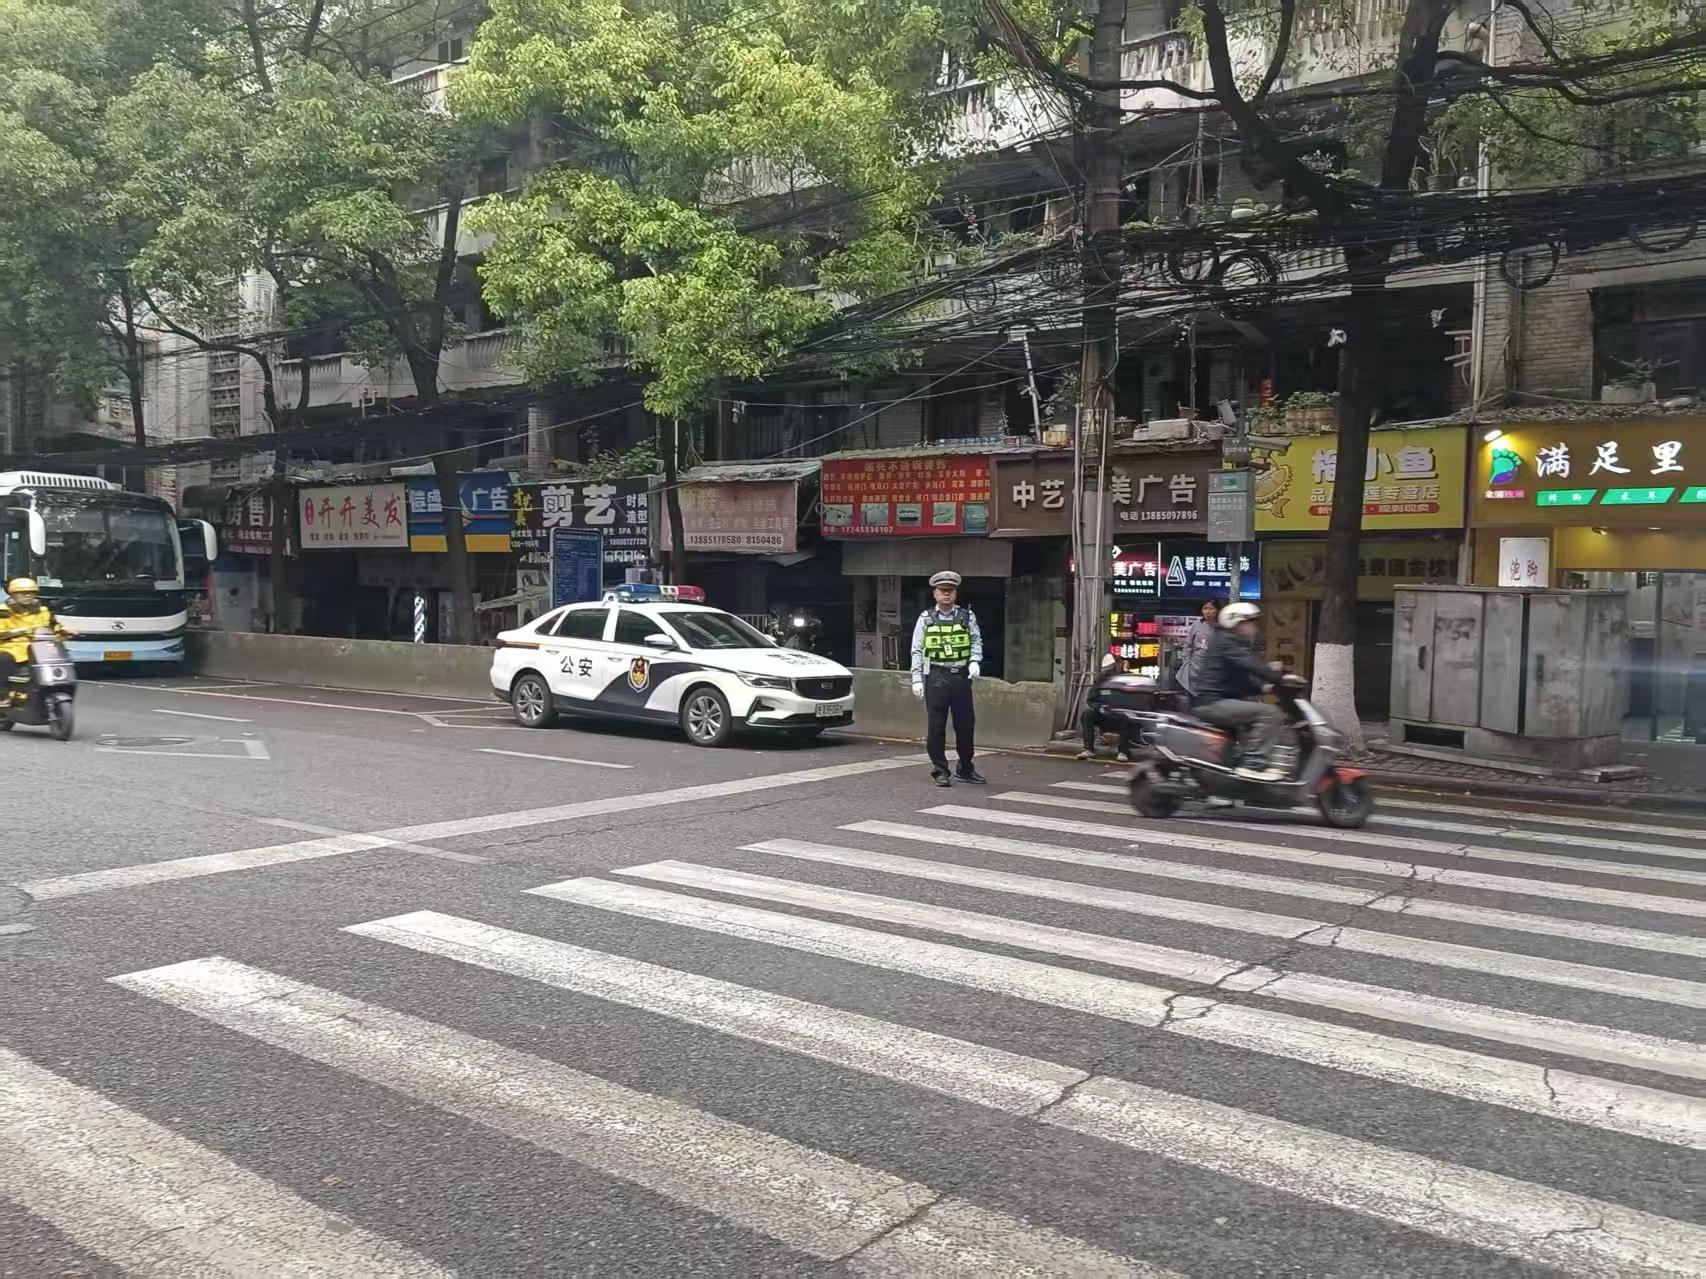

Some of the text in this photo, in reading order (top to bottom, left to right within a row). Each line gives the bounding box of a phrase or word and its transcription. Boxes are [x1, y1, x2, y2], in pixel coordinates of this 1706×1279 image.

[1535, 441, 1685, 479] 满足里
[472, 487, 508, 512] 广告
[541, 484, 617, 528] 剪艺
[626, 493, 648, 508] 时尚
[626, 510, 648, 525] 造型
[1120, 511, 1139, 521] 电话
[618, 526, 632, 535] SPA
[560, 654, 593, 678] 公安
